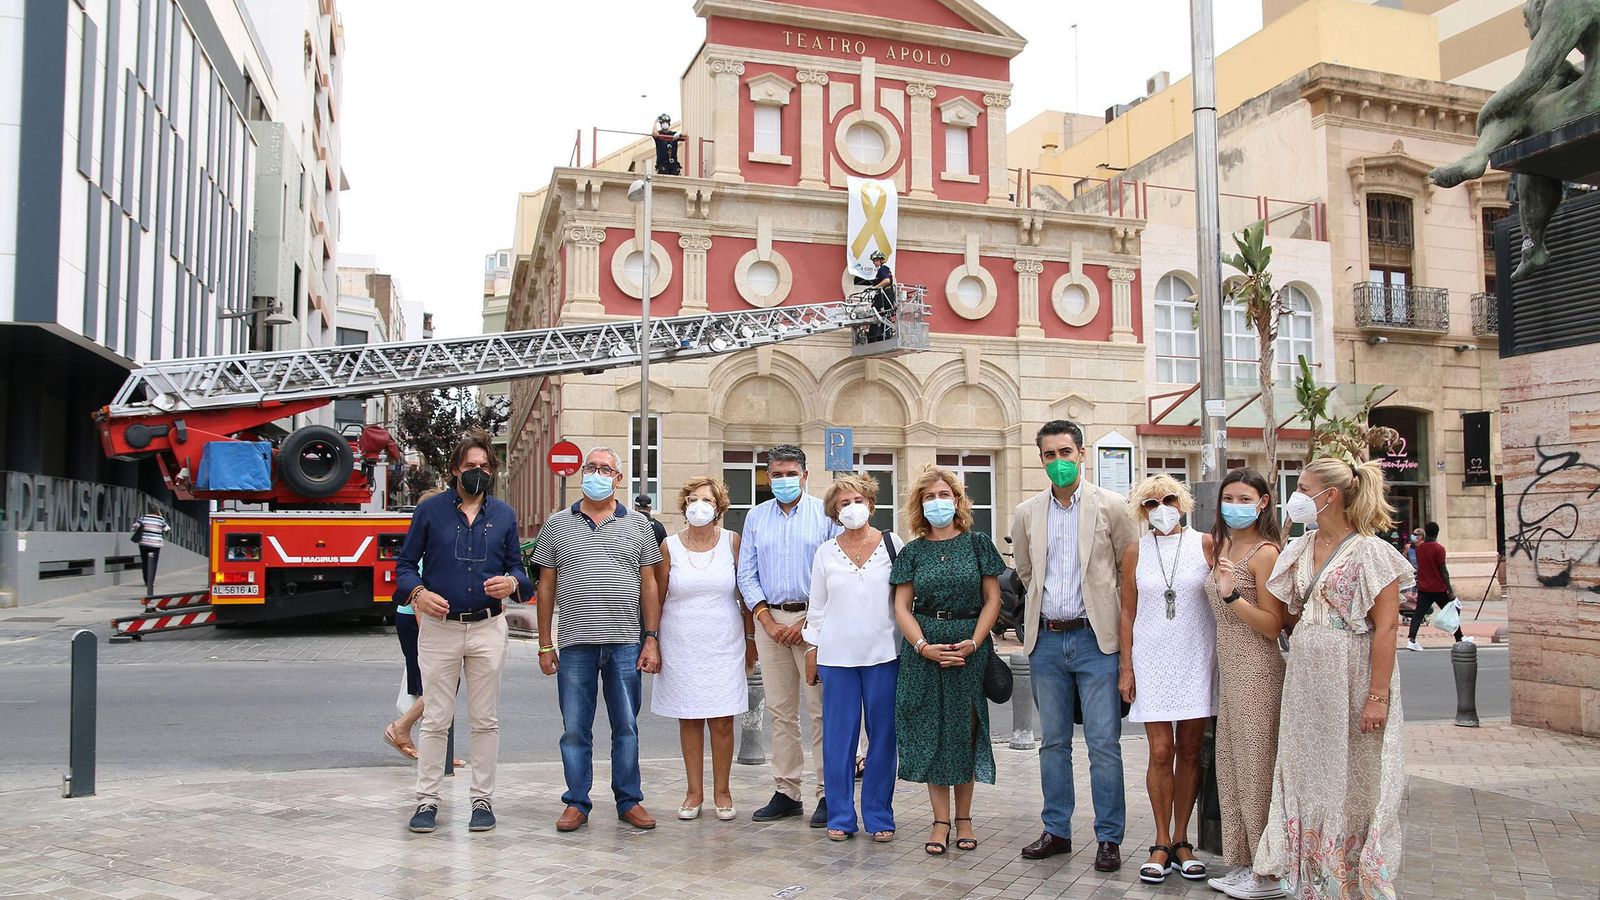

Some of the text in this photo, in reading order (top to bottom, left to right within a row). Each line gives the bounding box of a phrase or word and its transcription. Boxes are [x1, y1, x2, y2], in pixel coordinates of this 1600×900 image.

[782, 30, 951, 67] TEATRO APOLO
[830, 432, 846, 456] P
[54, 478, 114, 532] MUSICA
[213, 585, 258, 595] AL 5616 AG
